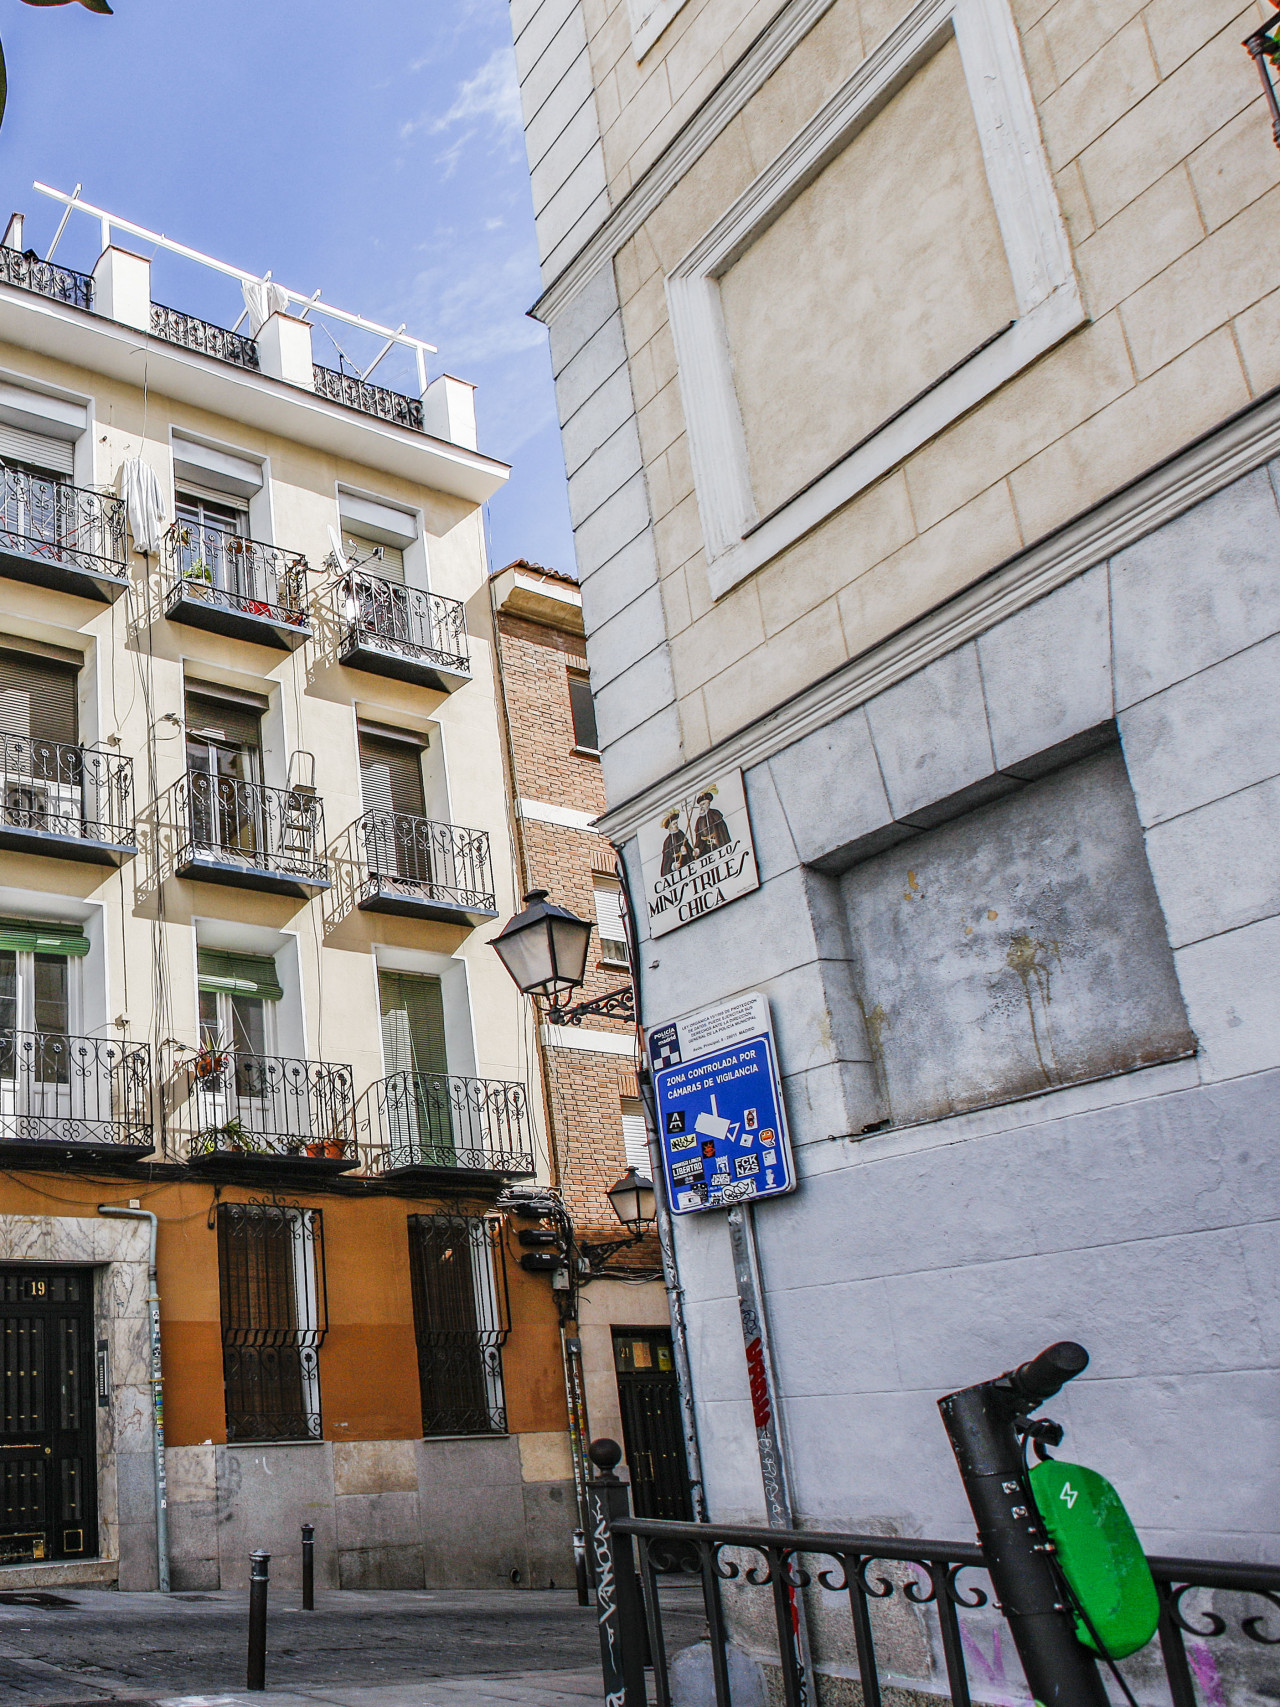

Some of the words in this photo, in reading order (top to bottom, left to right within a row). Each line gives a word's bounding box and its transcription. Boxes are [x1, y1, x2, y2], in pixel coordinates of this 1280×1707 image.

[648, 851, 749, 918] MINISTRILES
[654, 862, 697, 894] CALLE
[700, 854, 716, 869] DE
[718, 840, 740, 859] LOS
[678, 887, 727, 921] CHICA
[666, 1073, 687, 1087] ZONA
[687, 1056, 738, 1079] CONTROLADA
[739, 1049, 757, 1063] POR
[667, 1081, 702, 1100] CÁMARAS
[703, 1077, 715, 1089] DE
[715, 1063, 759, 1084] VIGILANCIA
[736, 1153, 758, 1168] FCK
[736, 1164, 760, 1176] NZS
[31, 1281, 46, 1296] 19
